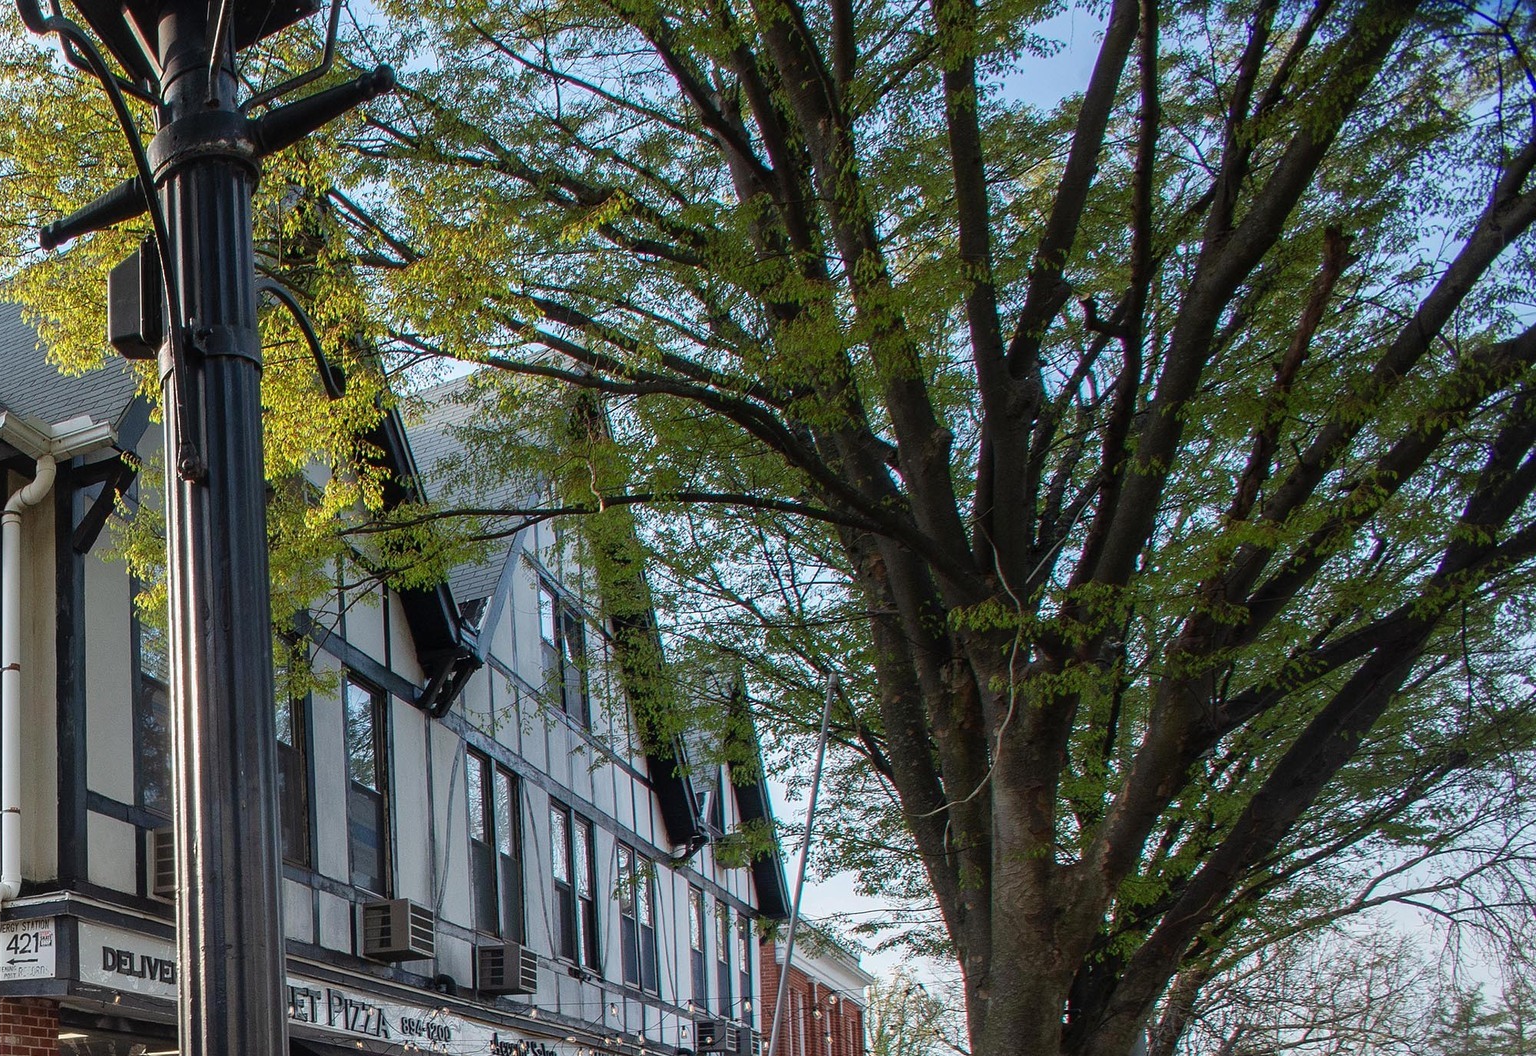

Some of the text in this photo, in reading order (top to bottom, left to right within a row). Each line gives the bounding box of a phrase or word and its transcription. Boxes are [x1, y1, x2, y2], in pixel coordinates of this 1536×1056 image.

[22, 918, 50, 931] STATION
[6, 932, 39, 954] 421
[326, 988, 391, 1039] PIZZA
[401, 1017, 451, 1042] 894-1200
